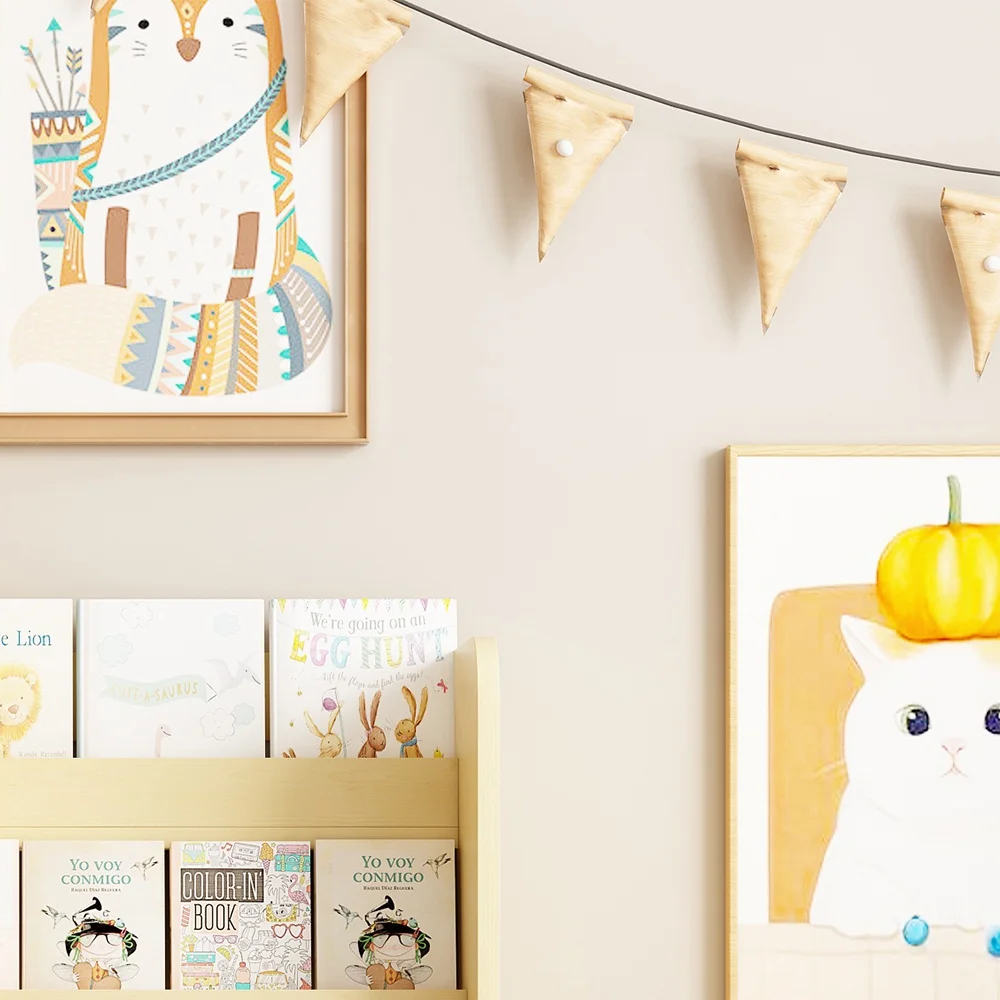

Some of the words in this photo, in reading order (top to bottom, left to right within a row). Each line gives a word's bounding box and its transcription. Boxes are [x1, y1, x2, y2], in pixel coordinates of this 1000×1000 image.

[310, 611, 344, 629] We're
[348, 617, 385, 634] going
[389, 615, 406, 629] on
[409, 614, 427, 627] an
[16, 630, 52, 647] Lion
[289, 628, 350, 669] EGG
[360, 627, 449, 669] HUNT
[61, 874, 132, 885] CONMIGO
[353, 872, 425, 883] CONMIGO
[193, 903, 237, 931] BOOK
